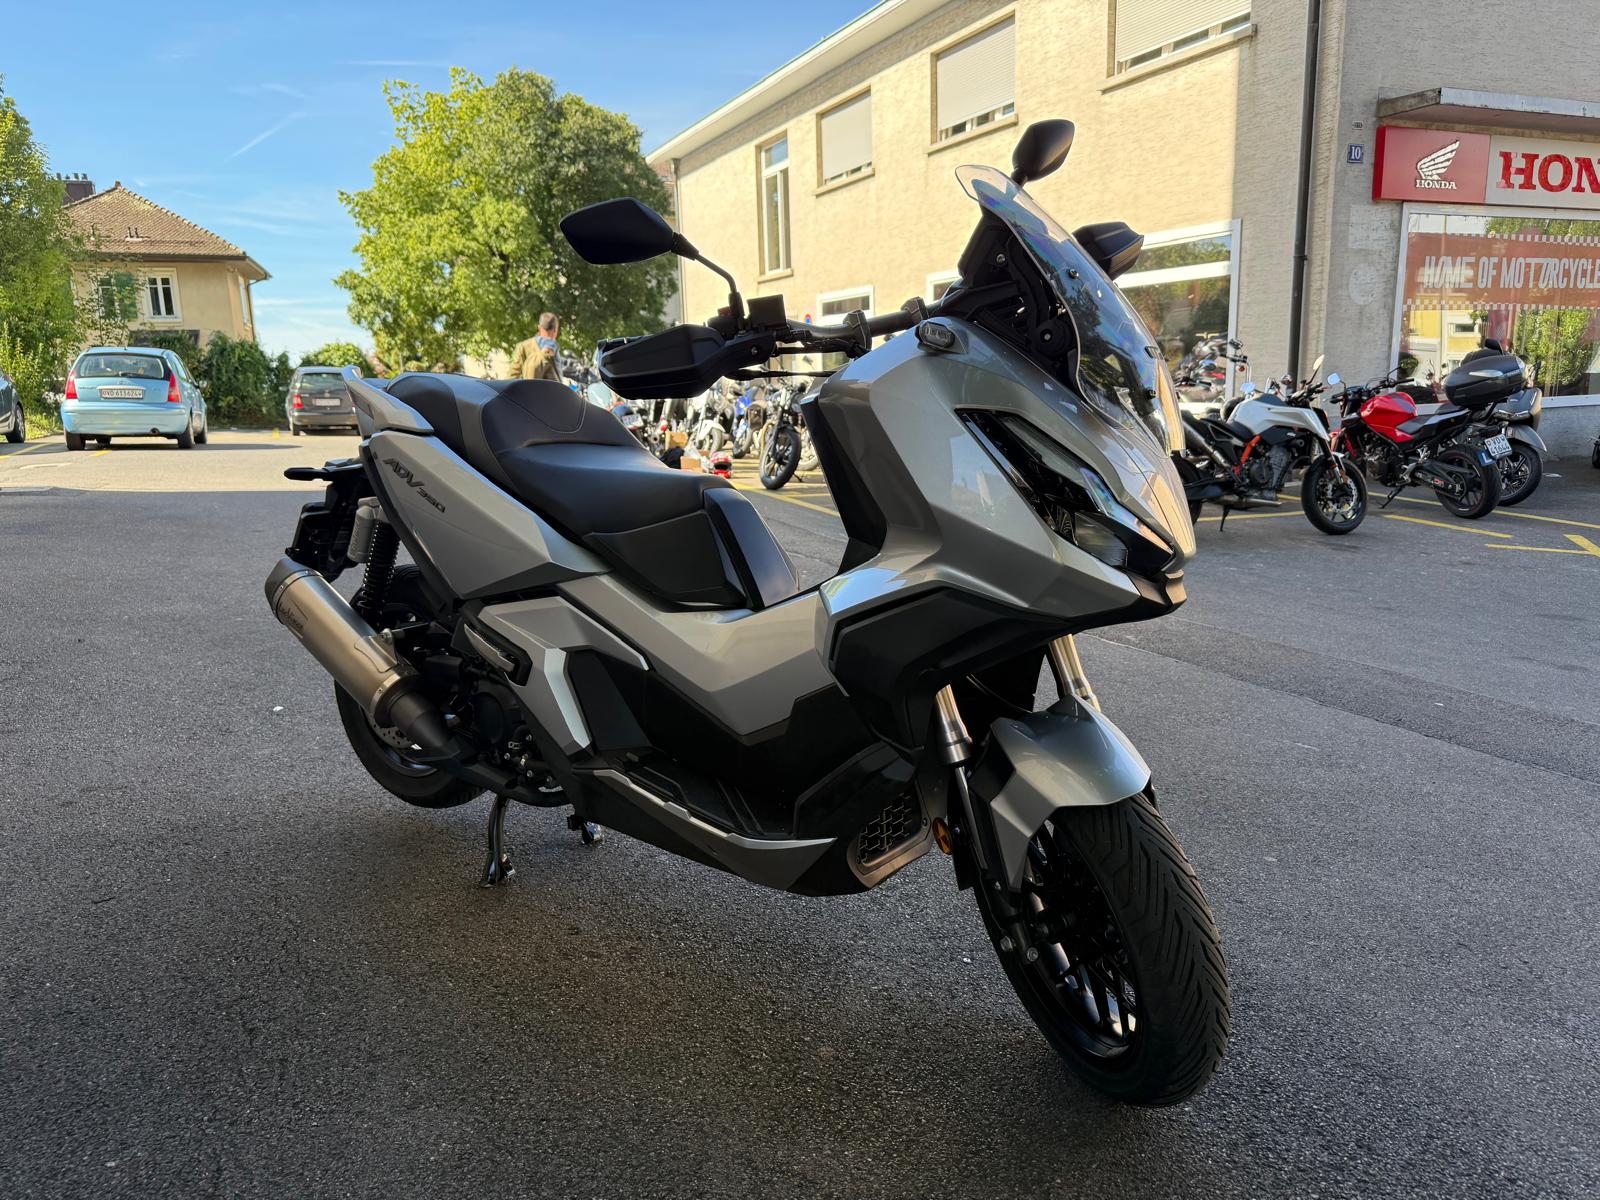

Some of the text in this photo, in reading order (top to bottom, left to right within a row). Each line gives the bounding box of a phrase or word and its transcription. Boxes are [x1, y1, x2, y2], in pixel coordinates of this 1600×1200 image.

[1351, 146, 1361, 160] 10
[1415, 179, 1457, 190] HONDA
[1423, 255, 1475, 289] HOME
[1477, 256, 1498, 289] OF
[382, 458, 446, 513] ADV 350
